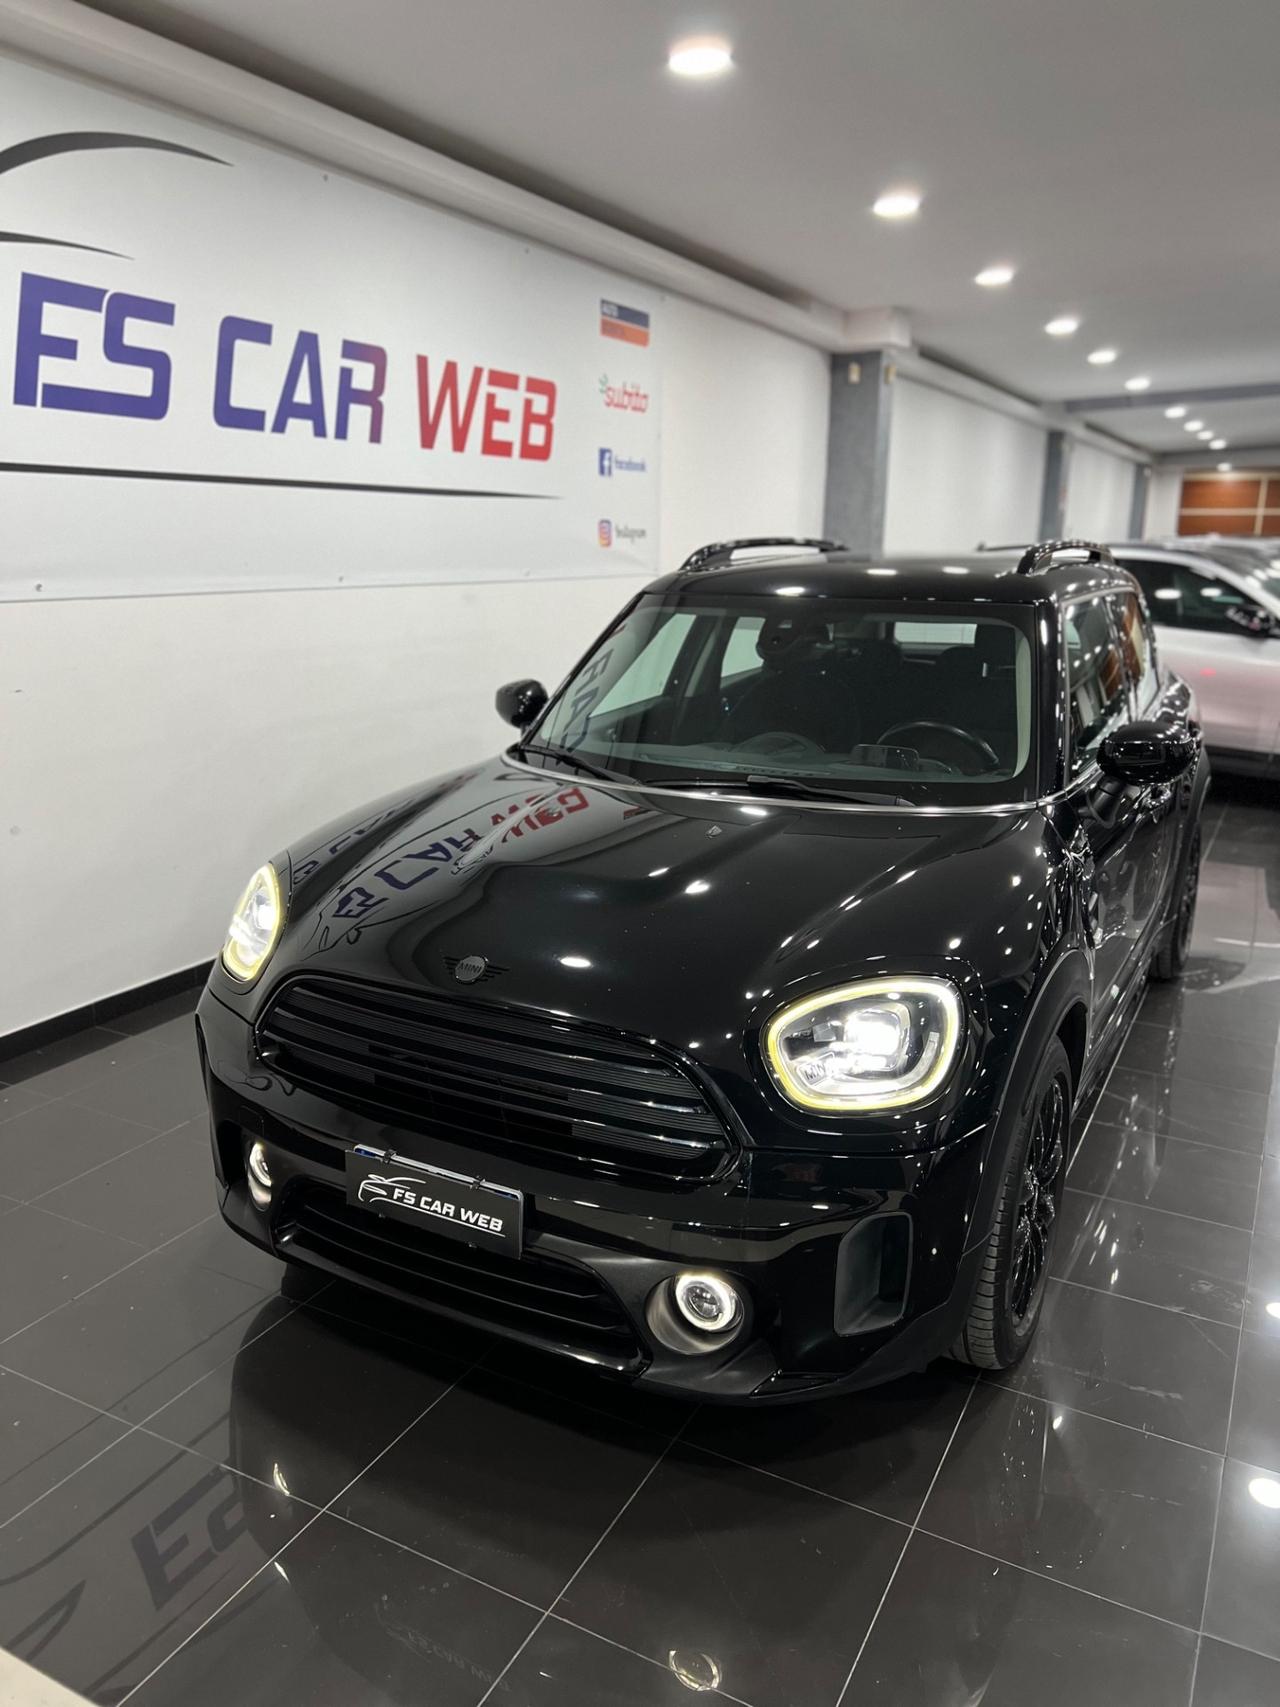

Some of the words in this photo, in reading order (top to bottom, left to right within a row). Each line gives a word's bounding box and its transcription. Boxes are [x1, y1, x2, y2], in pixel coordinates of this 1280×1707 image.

[13, 271, 176, 420] FS
[213, 315, 388, 444] CAR
[416, 354, 557, 462] WEB
[392, 1187, 416, 1205] FS
[420, 1195, 455, 1217] CAR
[460, 1208, 503, 1232] WEB
